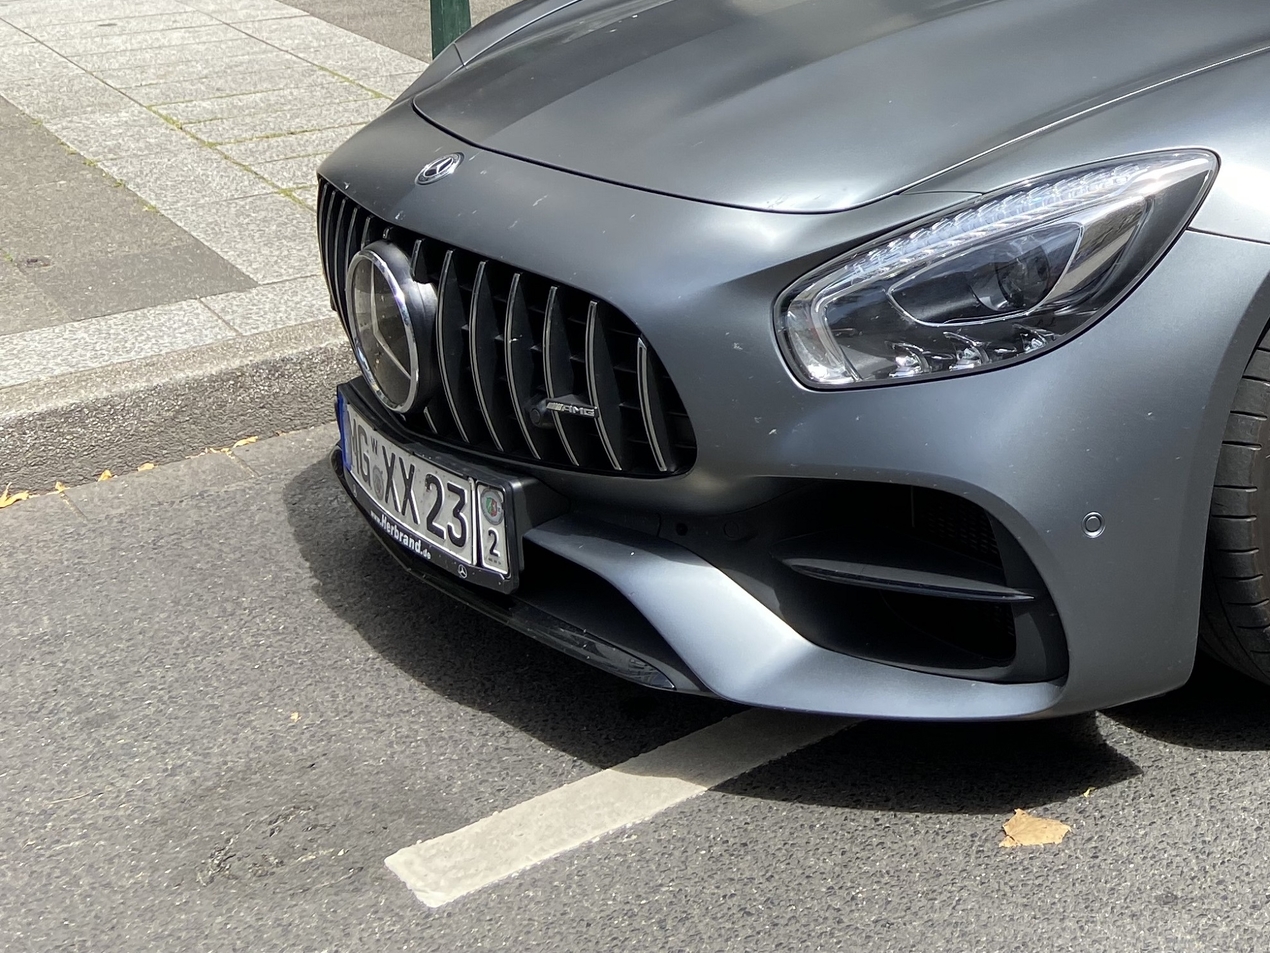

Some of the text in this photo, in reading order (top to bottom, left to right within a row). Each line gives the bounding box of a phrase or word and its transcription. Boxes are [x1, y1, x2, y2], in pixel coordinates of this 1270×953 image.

[561, 404, 595, 417] AMG
[381, 445, 420, 525] XX
[425, 473, 468, 549] 23
[370, 510, 431, 560] www.Herbrand.de
[487, 528, 500, 558] 2
